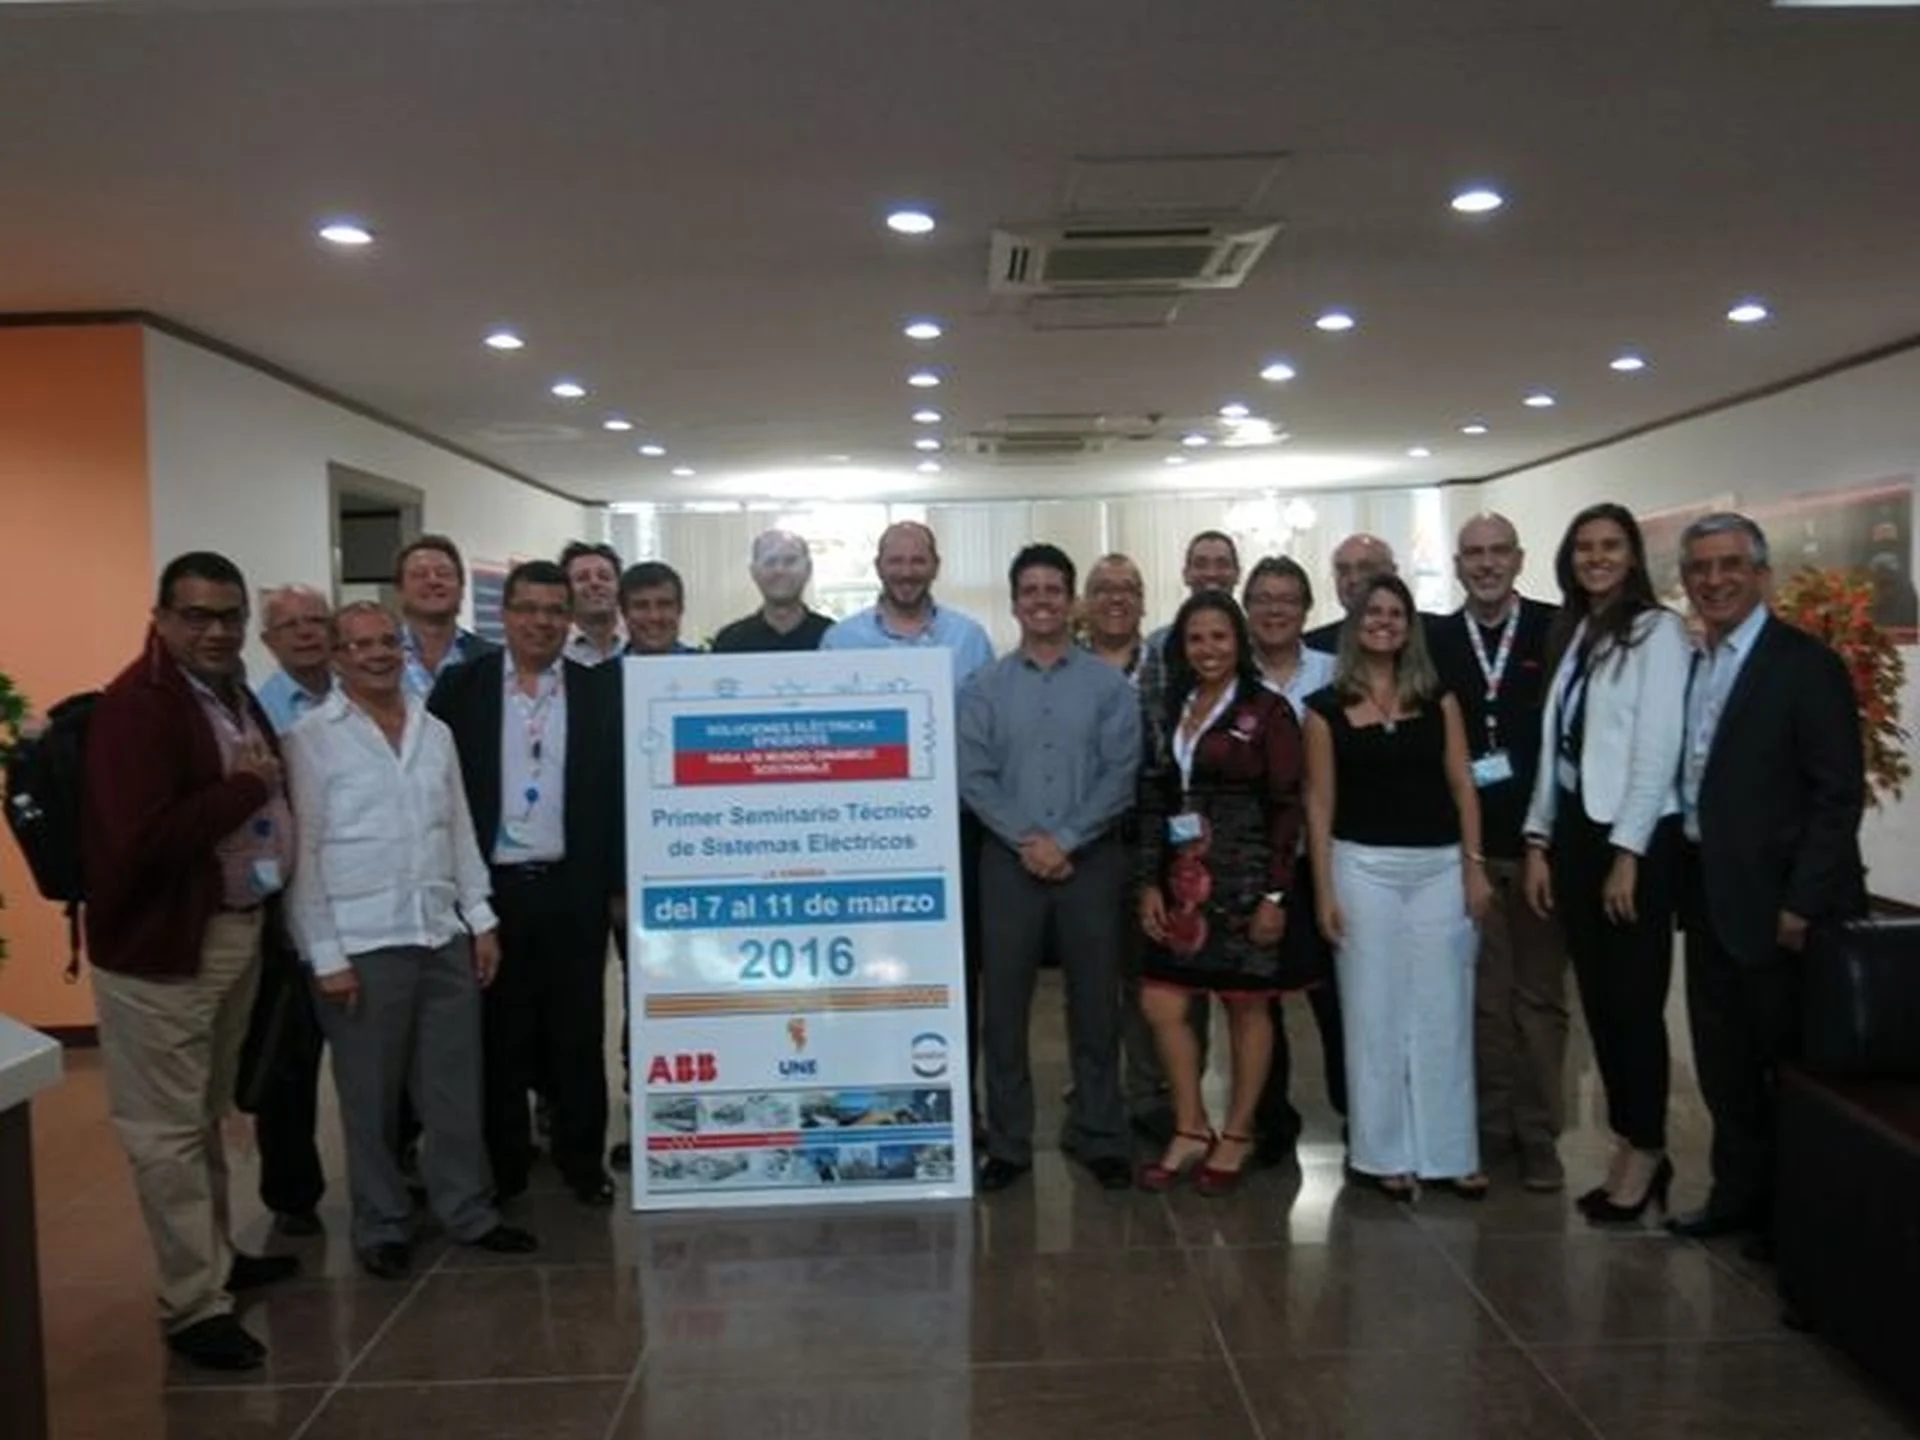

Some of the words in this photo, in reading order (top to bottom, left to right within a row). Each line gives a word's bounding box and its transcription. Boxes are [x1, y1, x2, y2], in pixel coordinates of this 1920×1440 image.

[652, 808, 723, 828] Primer
[729, 805, 840, 825] Seminario
[845, 800, 933, 822] Técnico
[668, 839, 695, 857] de
[701, 835, 800, 856] Sistemas
[655, 897, 697, 922] del
[704, 896, 724, 919] 7
[730, 894, 756, 918] al
[765, 894, 793, 917] 11
[804, 893, 839, 916] de
[847, 892, 935, 914] marzo
[738, 936, 856, 980] 2016
[648, 1053, 718, 1083] ABB
